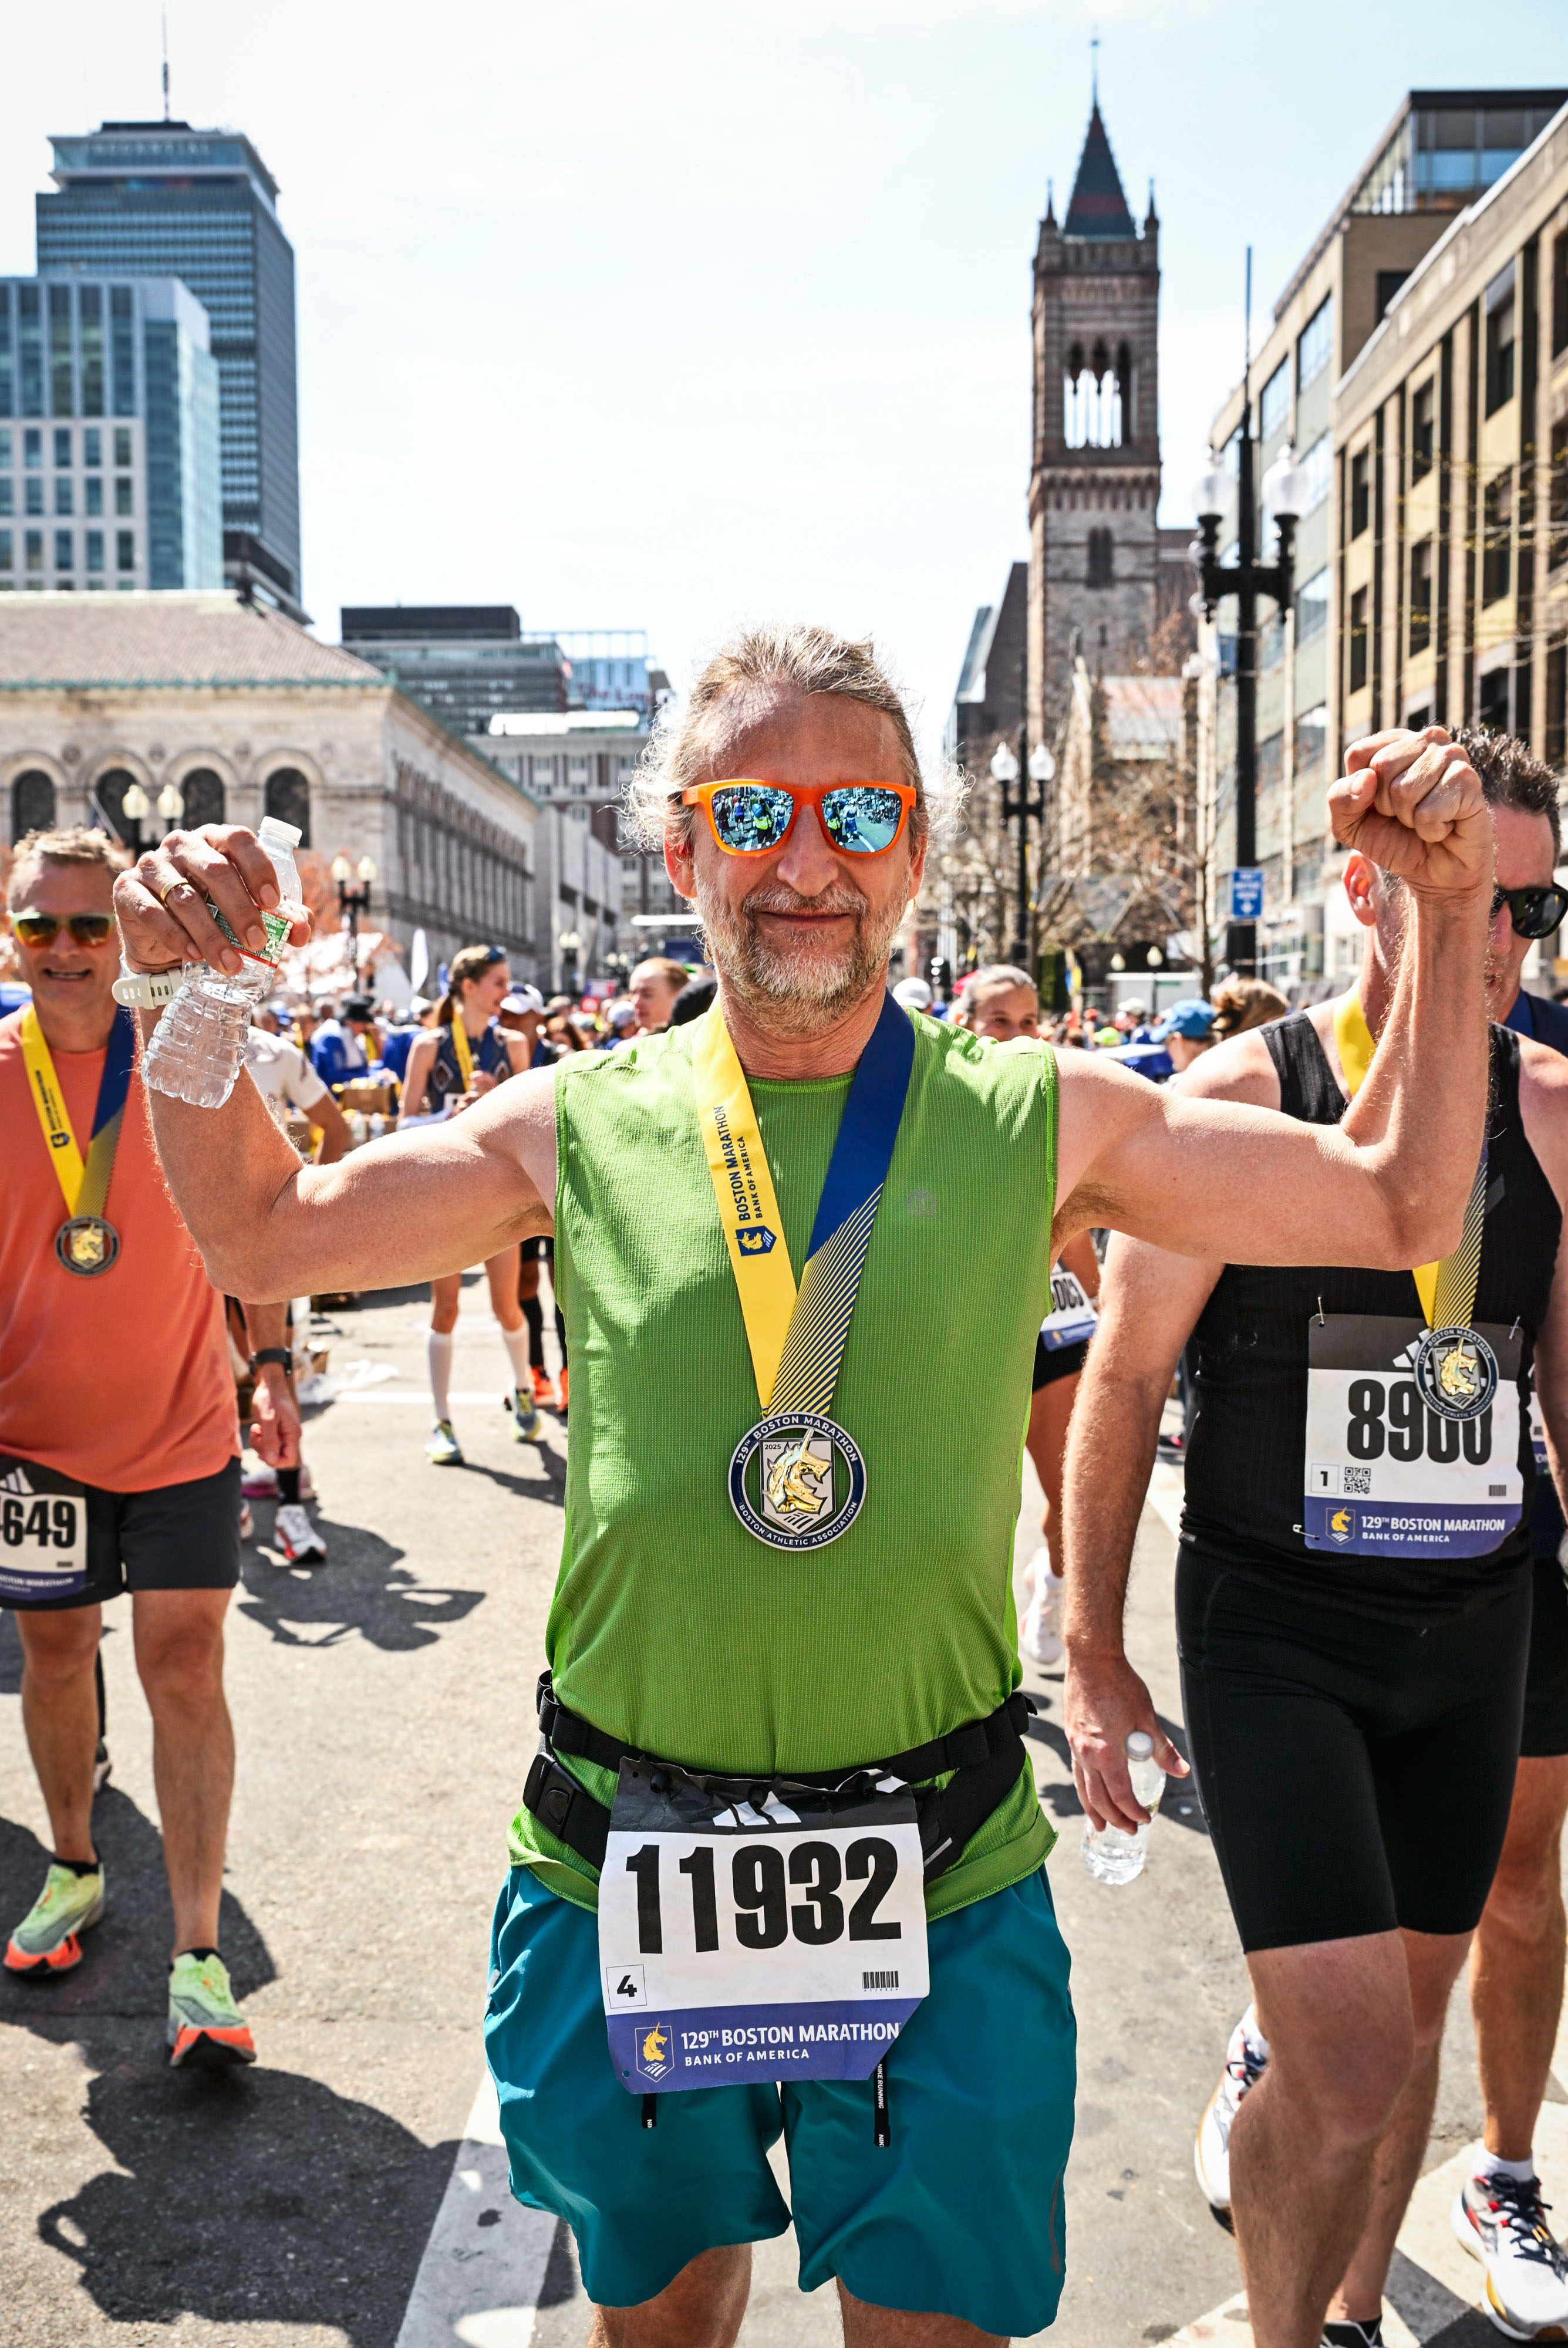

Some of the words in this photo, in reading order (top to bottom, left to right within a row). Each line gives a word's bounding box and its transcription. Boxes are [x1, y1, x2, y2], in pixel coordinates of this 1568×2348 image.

[713, 1105, 739, 1169] MARATHON
[737, 1136, 753, 1178] AMERICA
[729, 1171, 751, 1221] BOSTON
[748, 1179, 756, 1190] OF
[750, 1193, 763, 1218] BANK
[1427, 1329, 1455, 1347] BOSTON
[1456, 1330, 1492, 1359] MARATHON
[1347, 1379, 1492, 1465] 8900
[736, 1439, 751, 1465] 129TH
[753, 1416, 799, 1440] BOSTON
[804, 1416, 858, 1462] MARATHON
[1320, 1470, 1328, 1486] 1
[0, 1499, 76, 1549] 649
[739, 1503, 766, 1534] BOSTON
[766, 1533, 808, 1546] ATHLETIC
[811, 1501, 858, 1544] ASSOCIATION
[1361, 1516, 1390, 1529] 129TH
[1392, 1517, 1442, 1531] BOSTON
[1444, 1519, 1505, 1531] MARATHON
[1362, 1532, 1390, 1541] BANK
[1392, 1533, 1405, 1541] OF
[1407, 1534, 1451, 1543] AMERICA
[626, 1837, 902, 1954] 11932
[616, 1975, 638, 1998] 4
[681, 2029, 719, 2050] 129TH
[721, 2026, 794, 2046] BOSTON
[799, 2022, 899, 2042] MARATHON
[684, 2053, 722, 2066] BANK
[726, 2052, 743, 2063] OF
[746, 2049, 810, 2062] AMERICA
